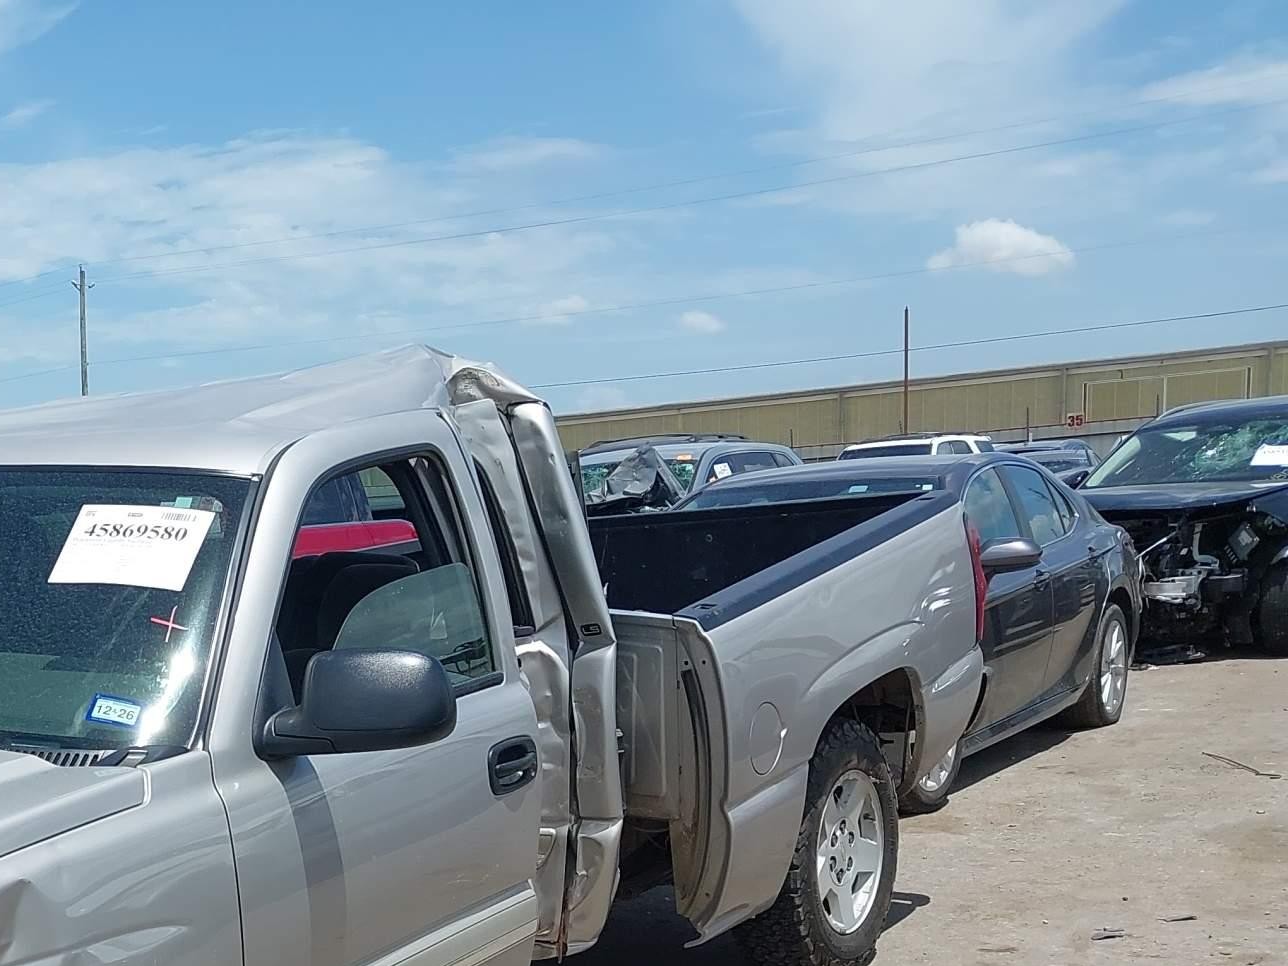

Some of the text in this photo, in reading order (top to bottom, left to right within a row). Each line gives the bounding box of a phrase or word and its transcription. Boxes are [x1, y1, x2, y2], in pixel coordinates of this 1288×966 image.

[1068, 415, 1083, 427] 35
[84, 523, 188, 542] 45869580
[96, 705, 135, 720] 12 26
